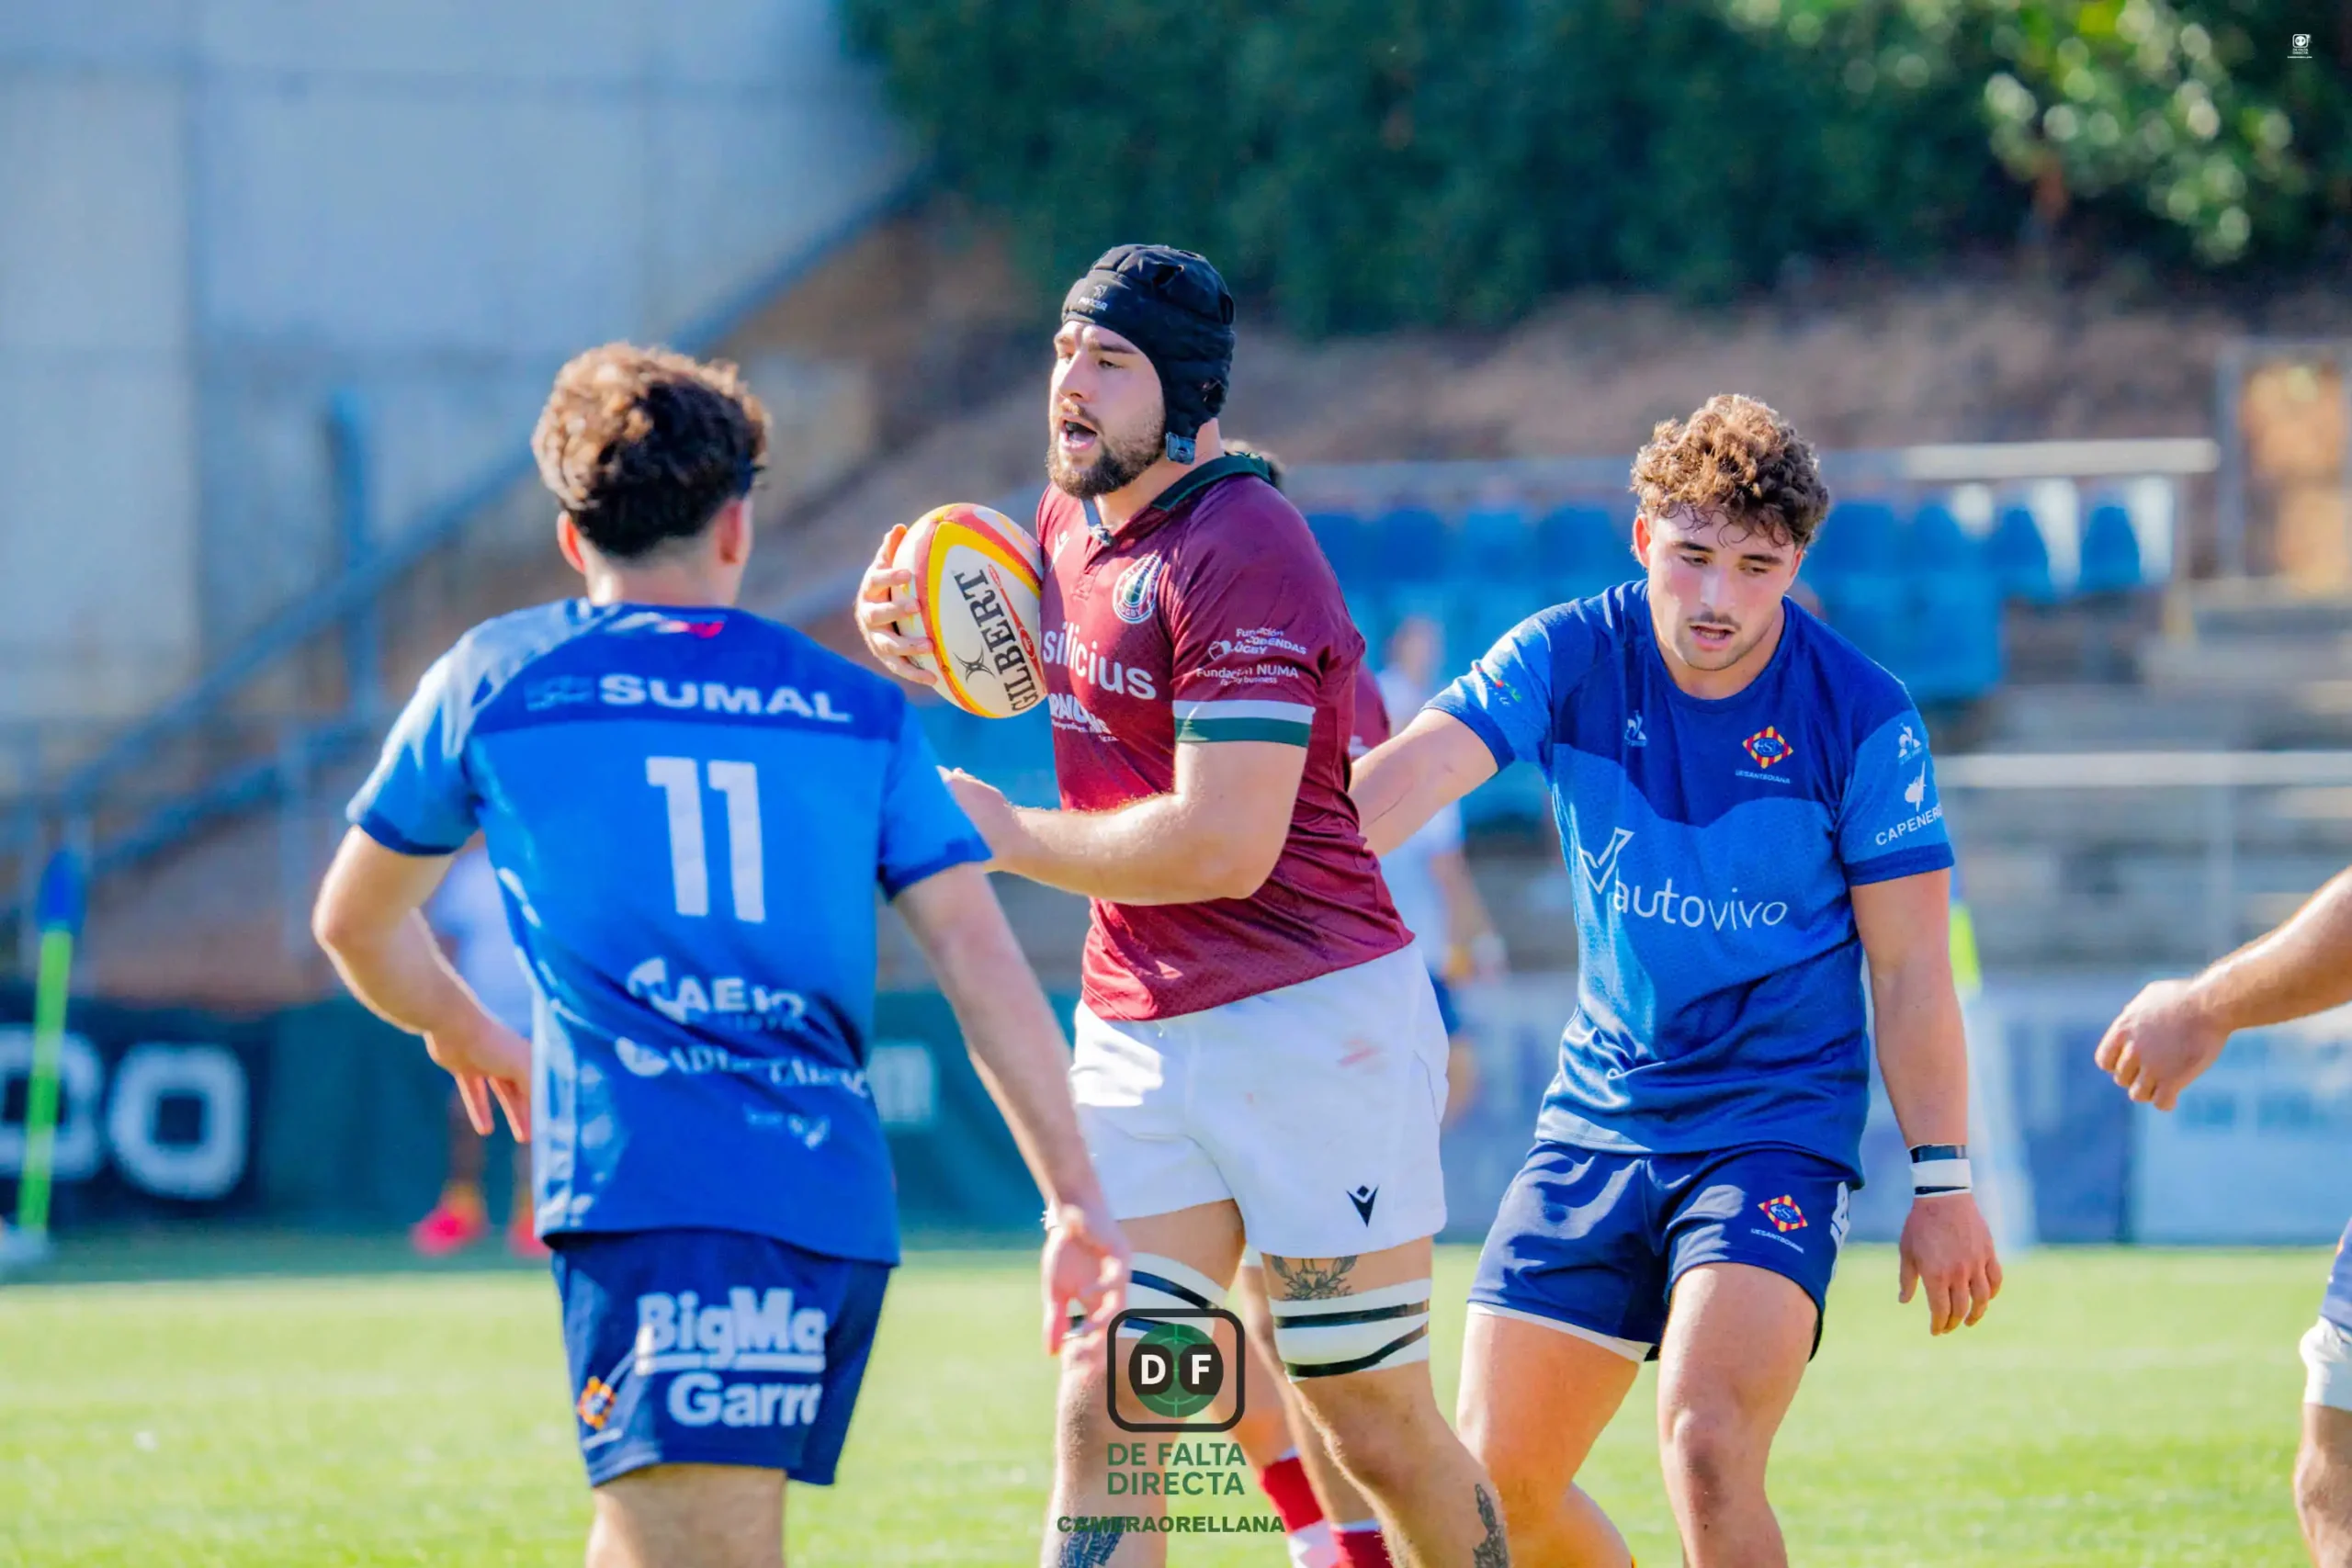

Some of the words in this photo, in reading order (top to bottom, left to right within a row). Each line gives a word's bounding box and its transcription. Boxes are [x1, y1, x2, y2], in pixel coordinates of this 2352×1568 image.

[954, 569, 1040, 712] GILBERT
[1043, 621, 1157, 700] silicius
[1256, 663, 1299, 679] NUMA
[598, 673, 854, 723] SUMAL
[645, 755, 766, 922] 11
[1612, 878, 1788, 931] autovivo
